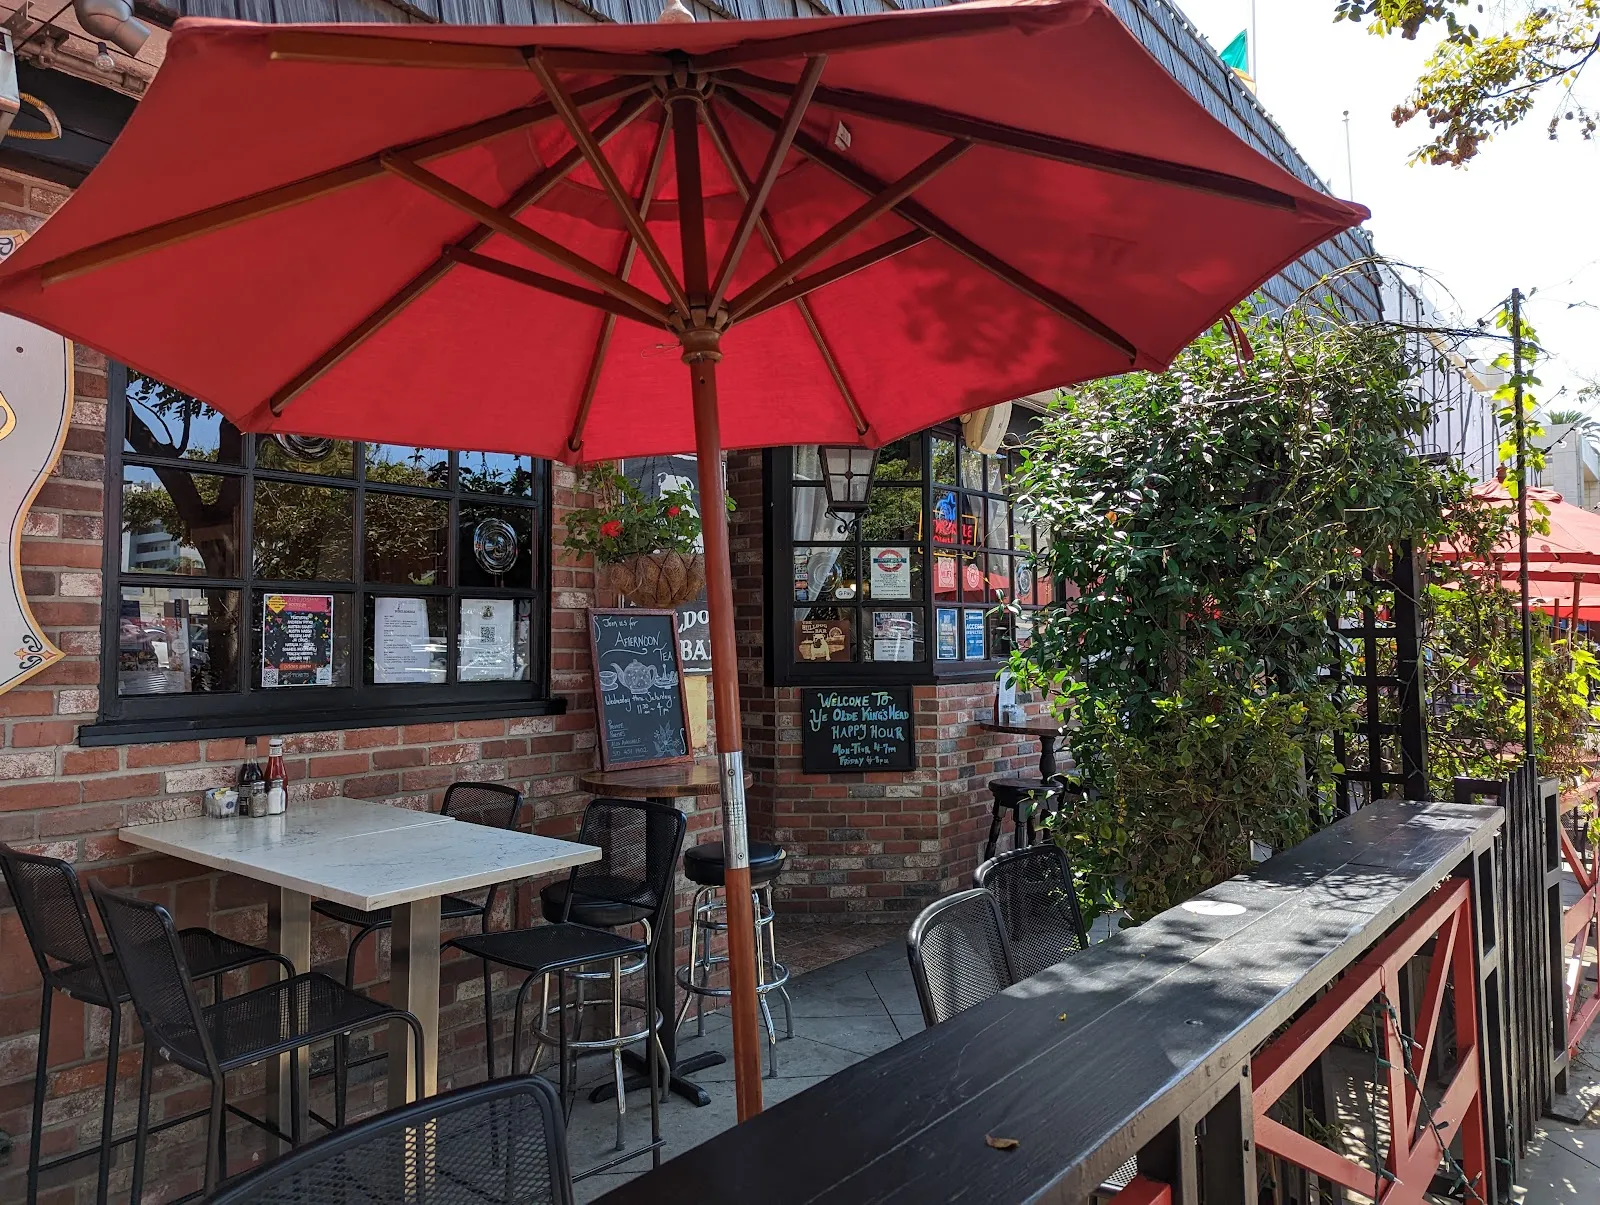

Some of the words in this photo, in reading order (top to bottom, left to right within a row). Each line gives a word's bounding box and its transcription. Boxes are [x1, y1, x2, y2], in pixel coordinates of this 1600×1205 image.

[602, 616, 618, 628] Join
[628, 617, 639, 630] for
[615, 631, 660, 648] AFTERNOON
[653, 643, 673, 661] TEA
[680, 640, 712, 660] BA
[605, 694, 632, 712] Wednesday
[818, 692, 870, 708] WELCOME
[833, 708, 859, 721] OLDE
[888, 704, 909, 720] HEAD
[831, 724, 866, 740] HAPPY
[870, 724, 905, 741] HOUR
